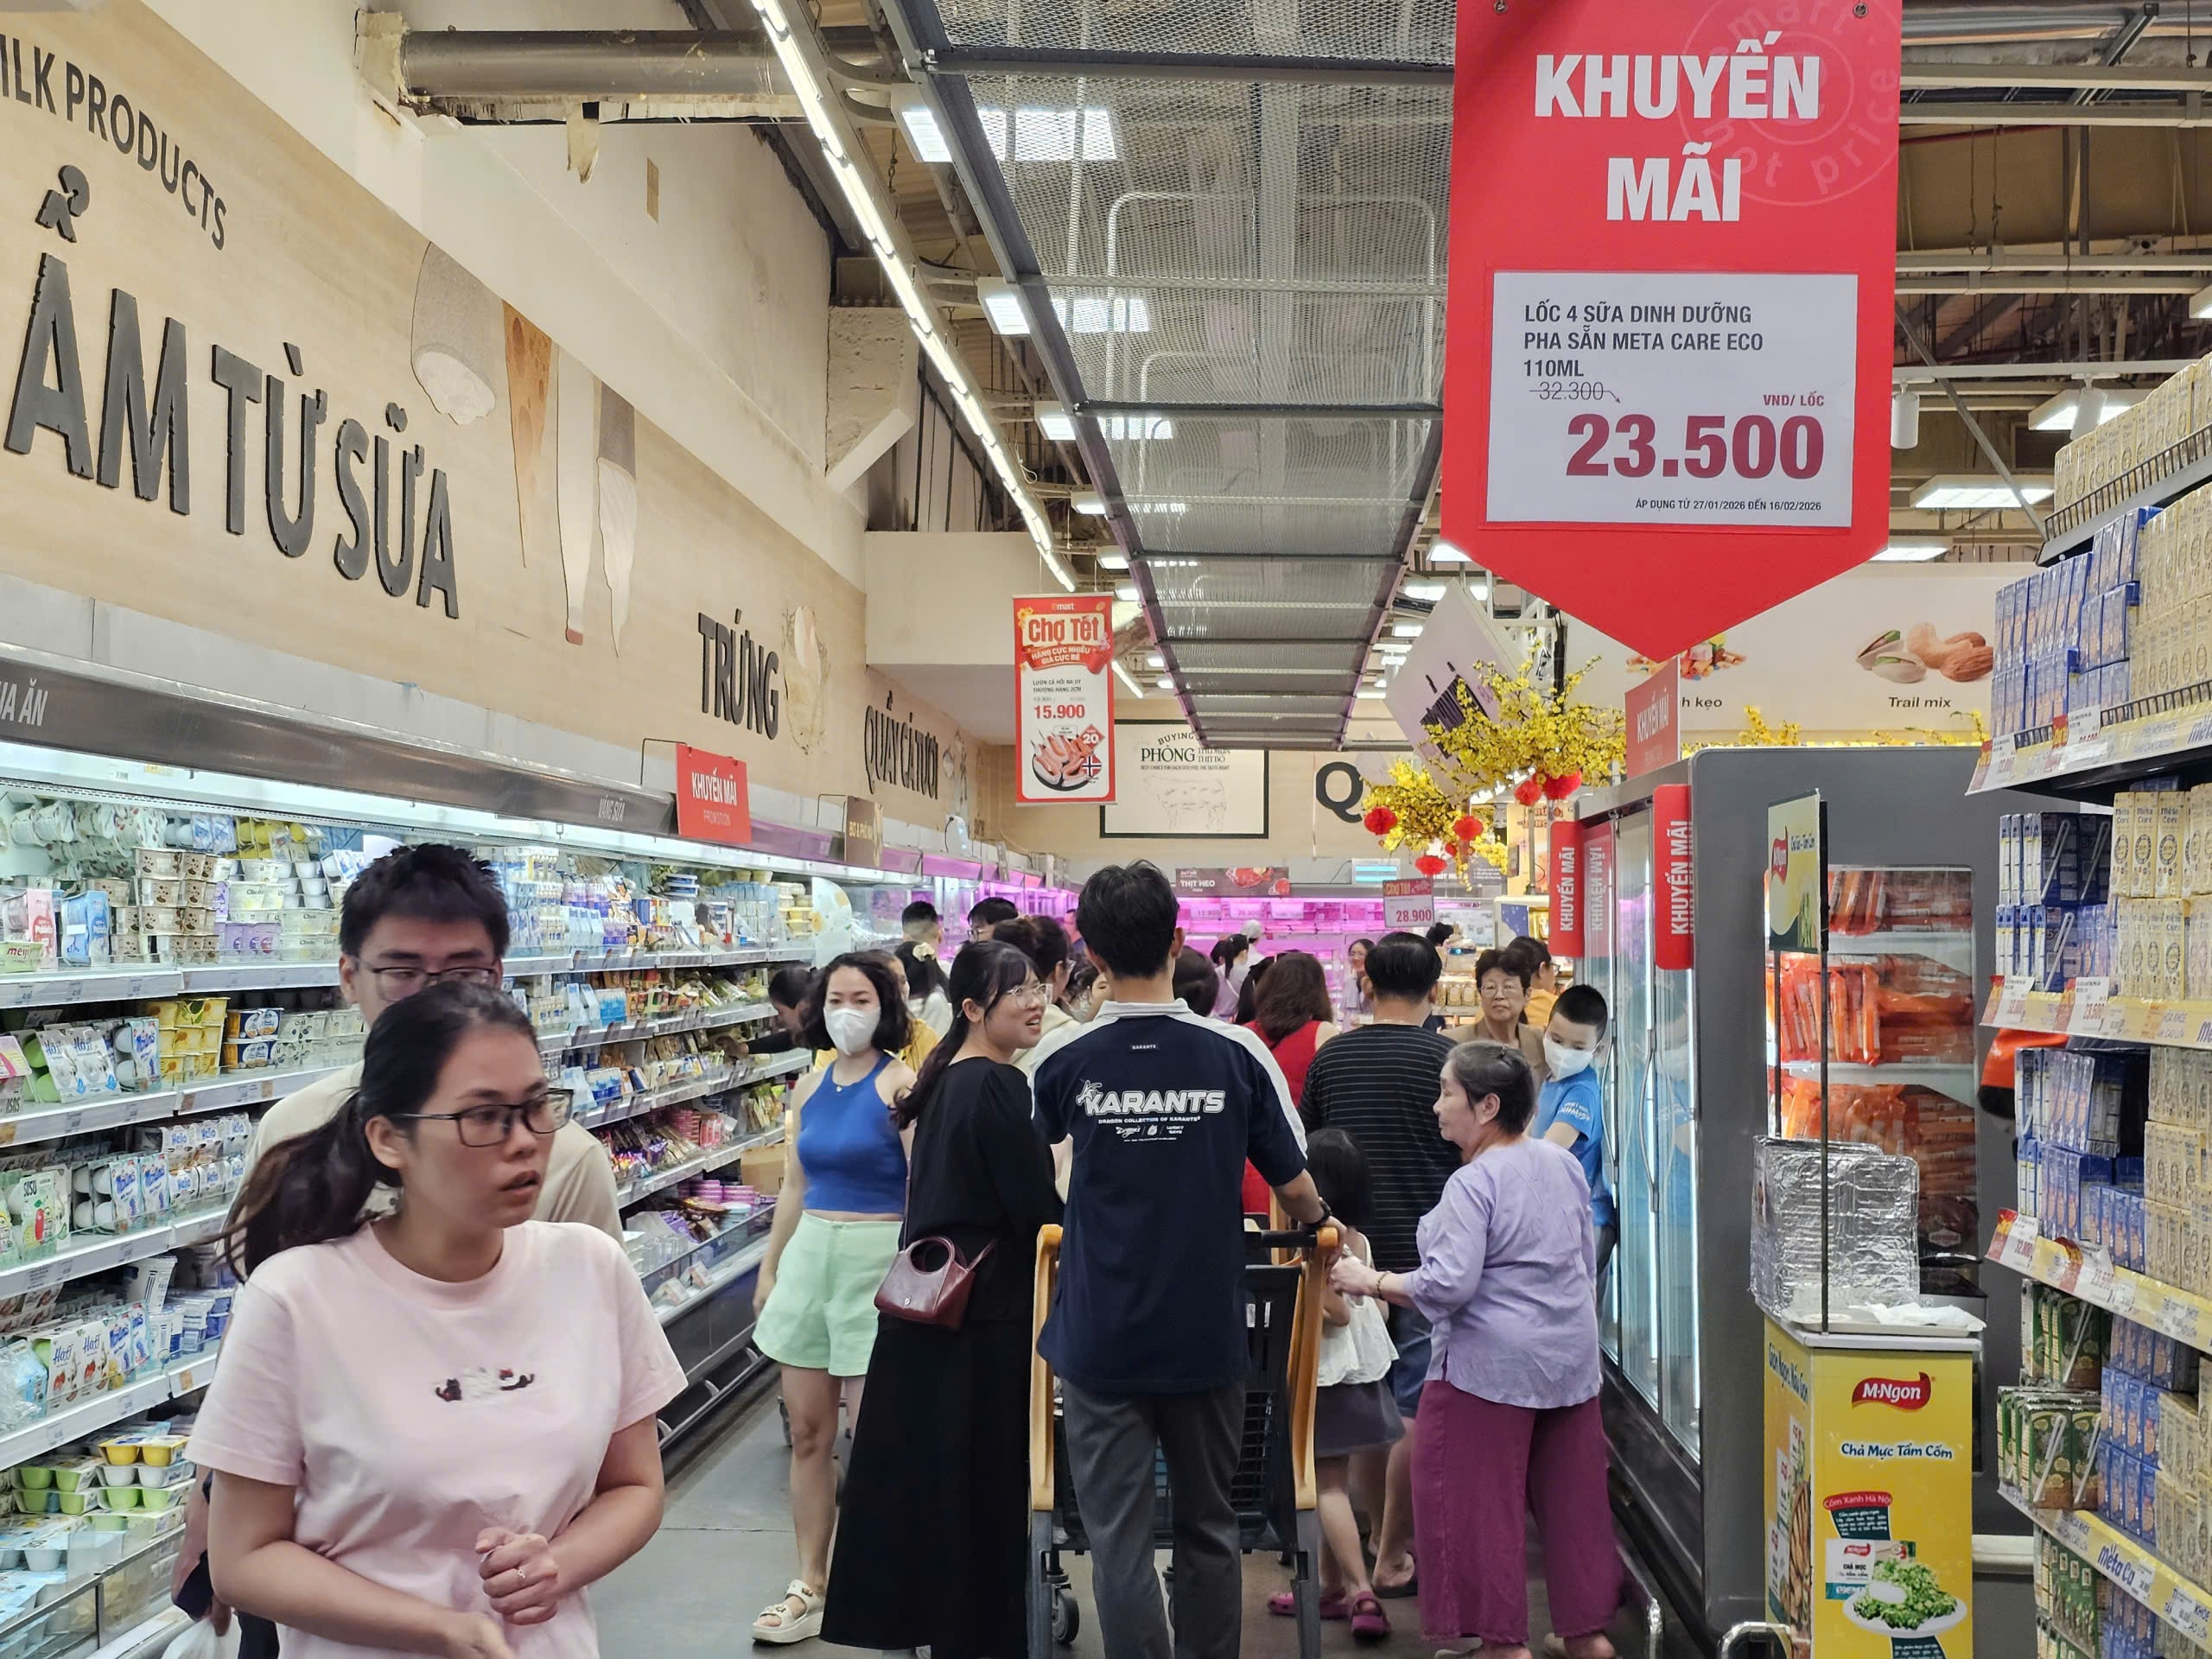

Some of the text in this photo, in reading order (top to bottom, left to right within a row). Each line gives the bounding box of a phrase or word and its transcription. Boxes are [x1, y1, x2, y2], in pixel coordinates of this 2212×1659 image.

[1535, 30, 1820, 119] KHUYẾN
[66, 61, 228, 251] PRODUCTS
[1606, 141, 1742, 222] MÃI
[1525, 299, 1752, 323] LỐC 4 SỮA DINH DƯỠNG
[1524, 324, 1764, 351] PHA SẴN META CARE ECO
[1523, 359, 1584, 377] 110ML
[1539, 381, 1604, 400] 32.300
[1763, 391, 1825, 407] VND/ LỐC
[1566, 413, 1824, 480] 23.500
[211, 341, 327, 559] TỪ
[334, 403, 460, 620] SỮA
[1635, 498, 1822, 512] ÁP DỤNG TỪ 27/01/2026 ĐẾN 16/02/2026
[1071, 615, 1099, 641] Tết
[698, 608, 779, 741] TRỨNG
[18, 677, 49, 728] ĂN
[1033, 704, 1085, 719] 15.900
[1695, 696, 1723, 710] kẹo
[1888, 696, 1951, 709] Trail mix
[1083, 733, 1099, 744] 20
[1158, 732, 1194, 746] BUYING
[1141, 744, 1195, 763] PHÒNG
[691, 766, 723, 802] KHUYẾN
[1315, 760, 1363, 823] Q
[1557, 846, 1575, 931] KHUYẾN MÃI
[1665, 820, 1688, 935] KHUYẾN MÃI
[1395, 909, 1432, 923] 28.900
[7, 946, 30, 959] meiji
[1082, 1090, 1225, 1116] KARANTS
[1841, 1443, 1865, 1457] Chả
[1867, 1444, 1894, 1460] Mực
[1925, 1444, 1953, 1459] Cốm
[1843, 1495, 1864, 1503] Xanh
